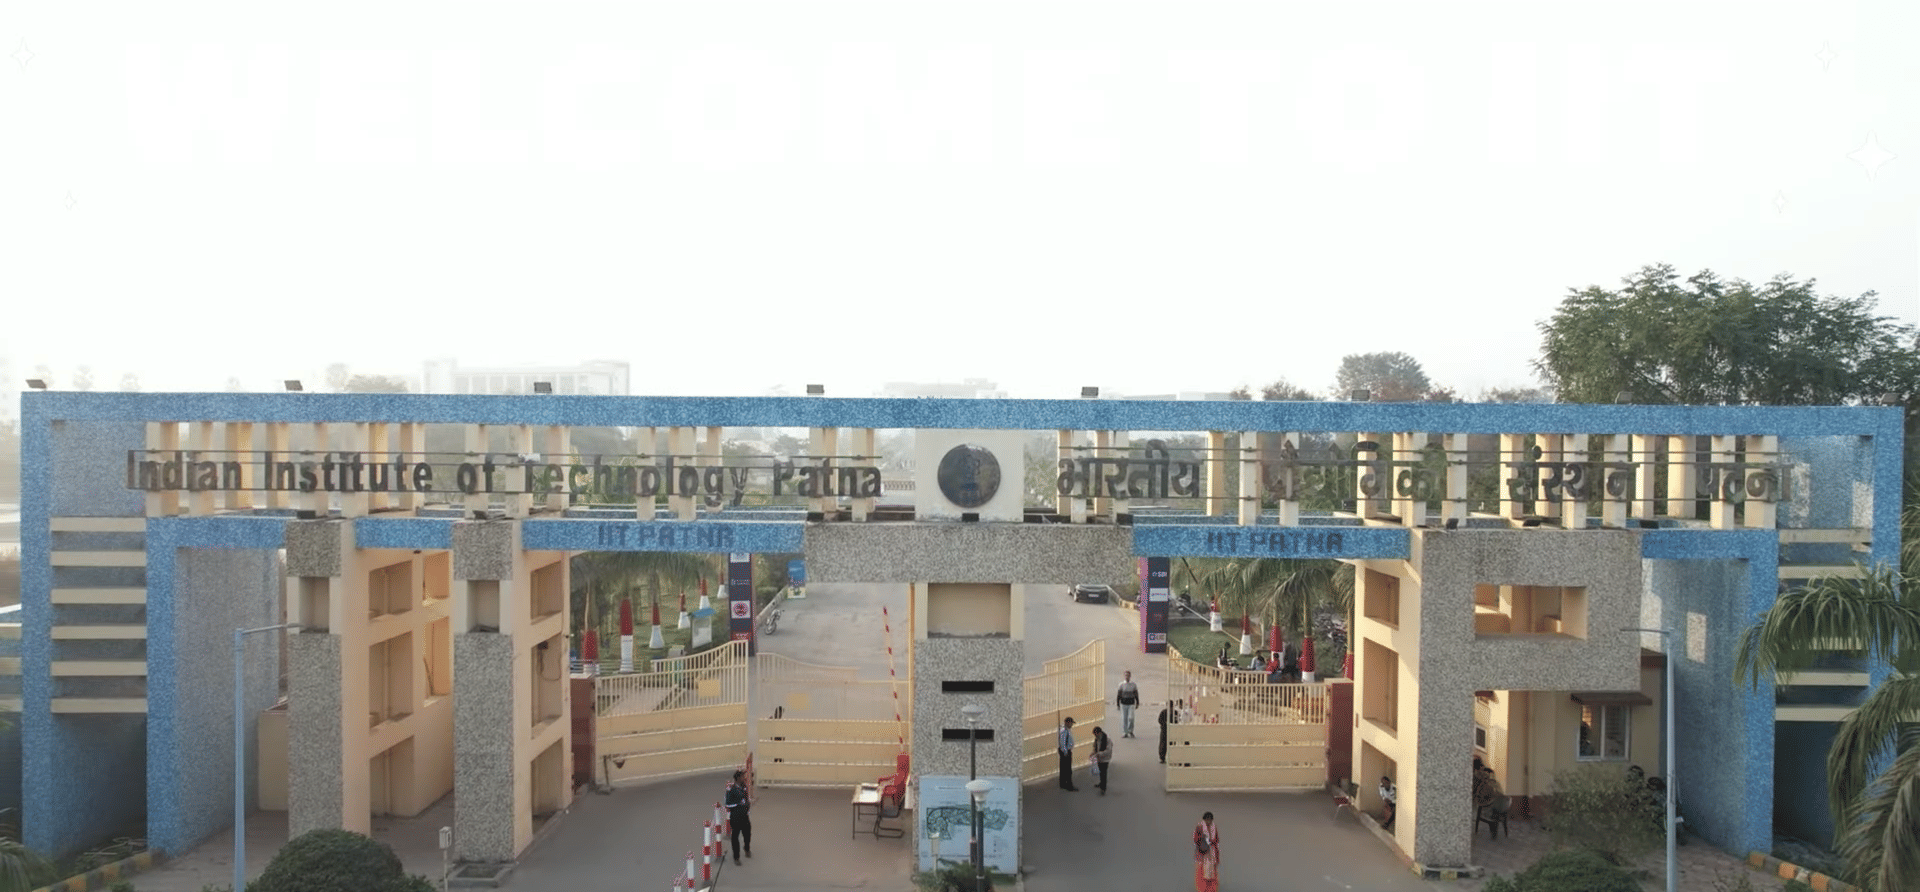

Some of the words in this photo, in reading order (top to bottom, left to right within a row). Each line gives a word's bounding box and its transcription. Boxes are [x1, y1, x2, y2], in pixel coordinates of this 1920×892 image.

[127, 450, 242, 491] Indian
[265, 451, 434, 493] Institute
[457, 452, 497, 493] of
[773, 457, 882, 499] Patna
[1057, 439, 1203, 499] भारतीय
[598, 525, 629, 546] IIT
[638, 526, 734, 548] PATNA
[1207, 532, 1240, 553] IIT
[1250, 532, 1343, 553] PATNA
